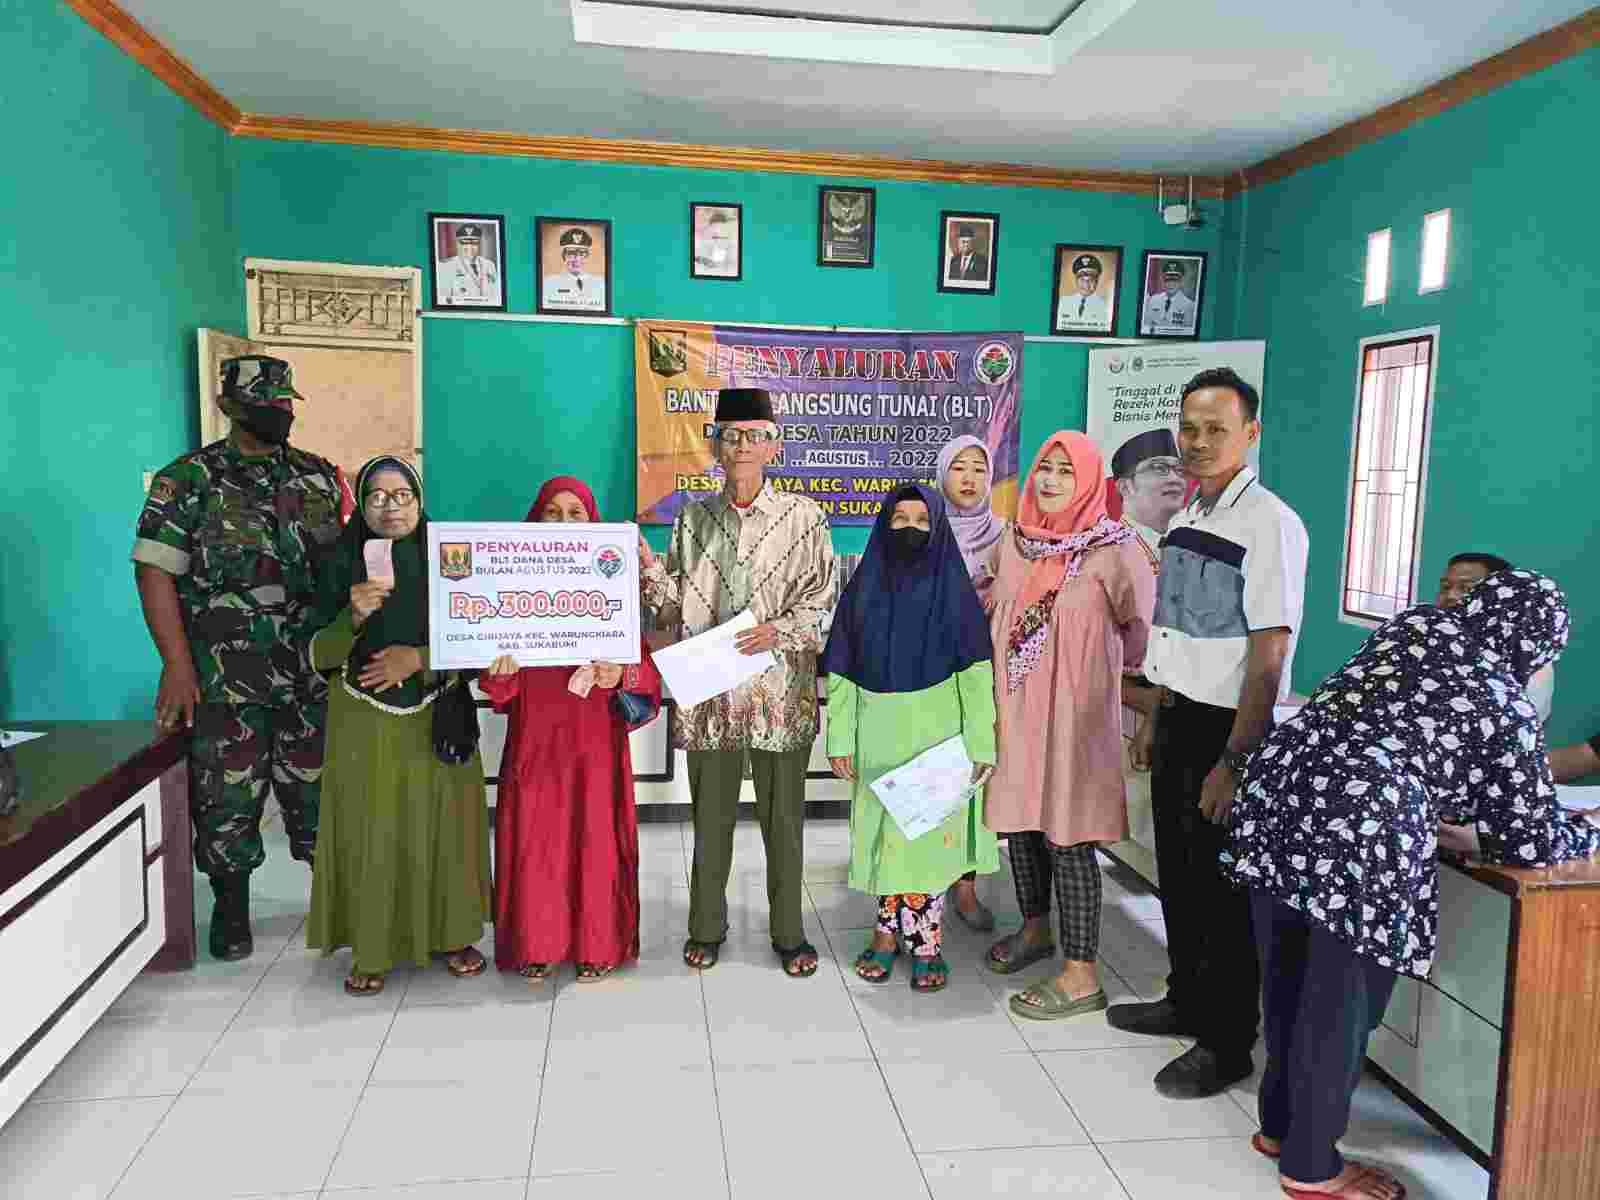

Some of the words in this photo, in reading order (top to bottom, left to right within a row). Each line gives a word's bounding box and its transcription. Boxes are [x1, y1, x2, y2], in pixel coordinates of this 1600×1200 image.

[704, 345, 959, 381] PENYALURAN
[877, 394, 938, 418] TUNAI
[943, 395, 994, 422] (BLT)
[1113, 400, 1154, 410] Rezeki
[1113, 411, 1151, 422] Bisnis
[829, 426, 897, 442] TAHUN
[902, 427, 952, 443] 2022
[890, 450, 938, 467] 2022
[675, 475, 722, 492] DESA
[810, 479, 848, 493] KEC.
[475, 541, 589, 553] PENYALURAN
[490, 556, 509, 564] BLT
[513, 556, 543, 564] DANA
[547, 556, 576, 564] DESA
[475, 567, 513, 576] BULAN
[516, 566, 566, 575] AGUSTUS
[446, 632, 474, 642] DESA
[525, 631, 547, 640] KEC.
[550, 630, 626, 640] WARUNGKIARA
[525, 640, 578, 649] SUKABUMI
